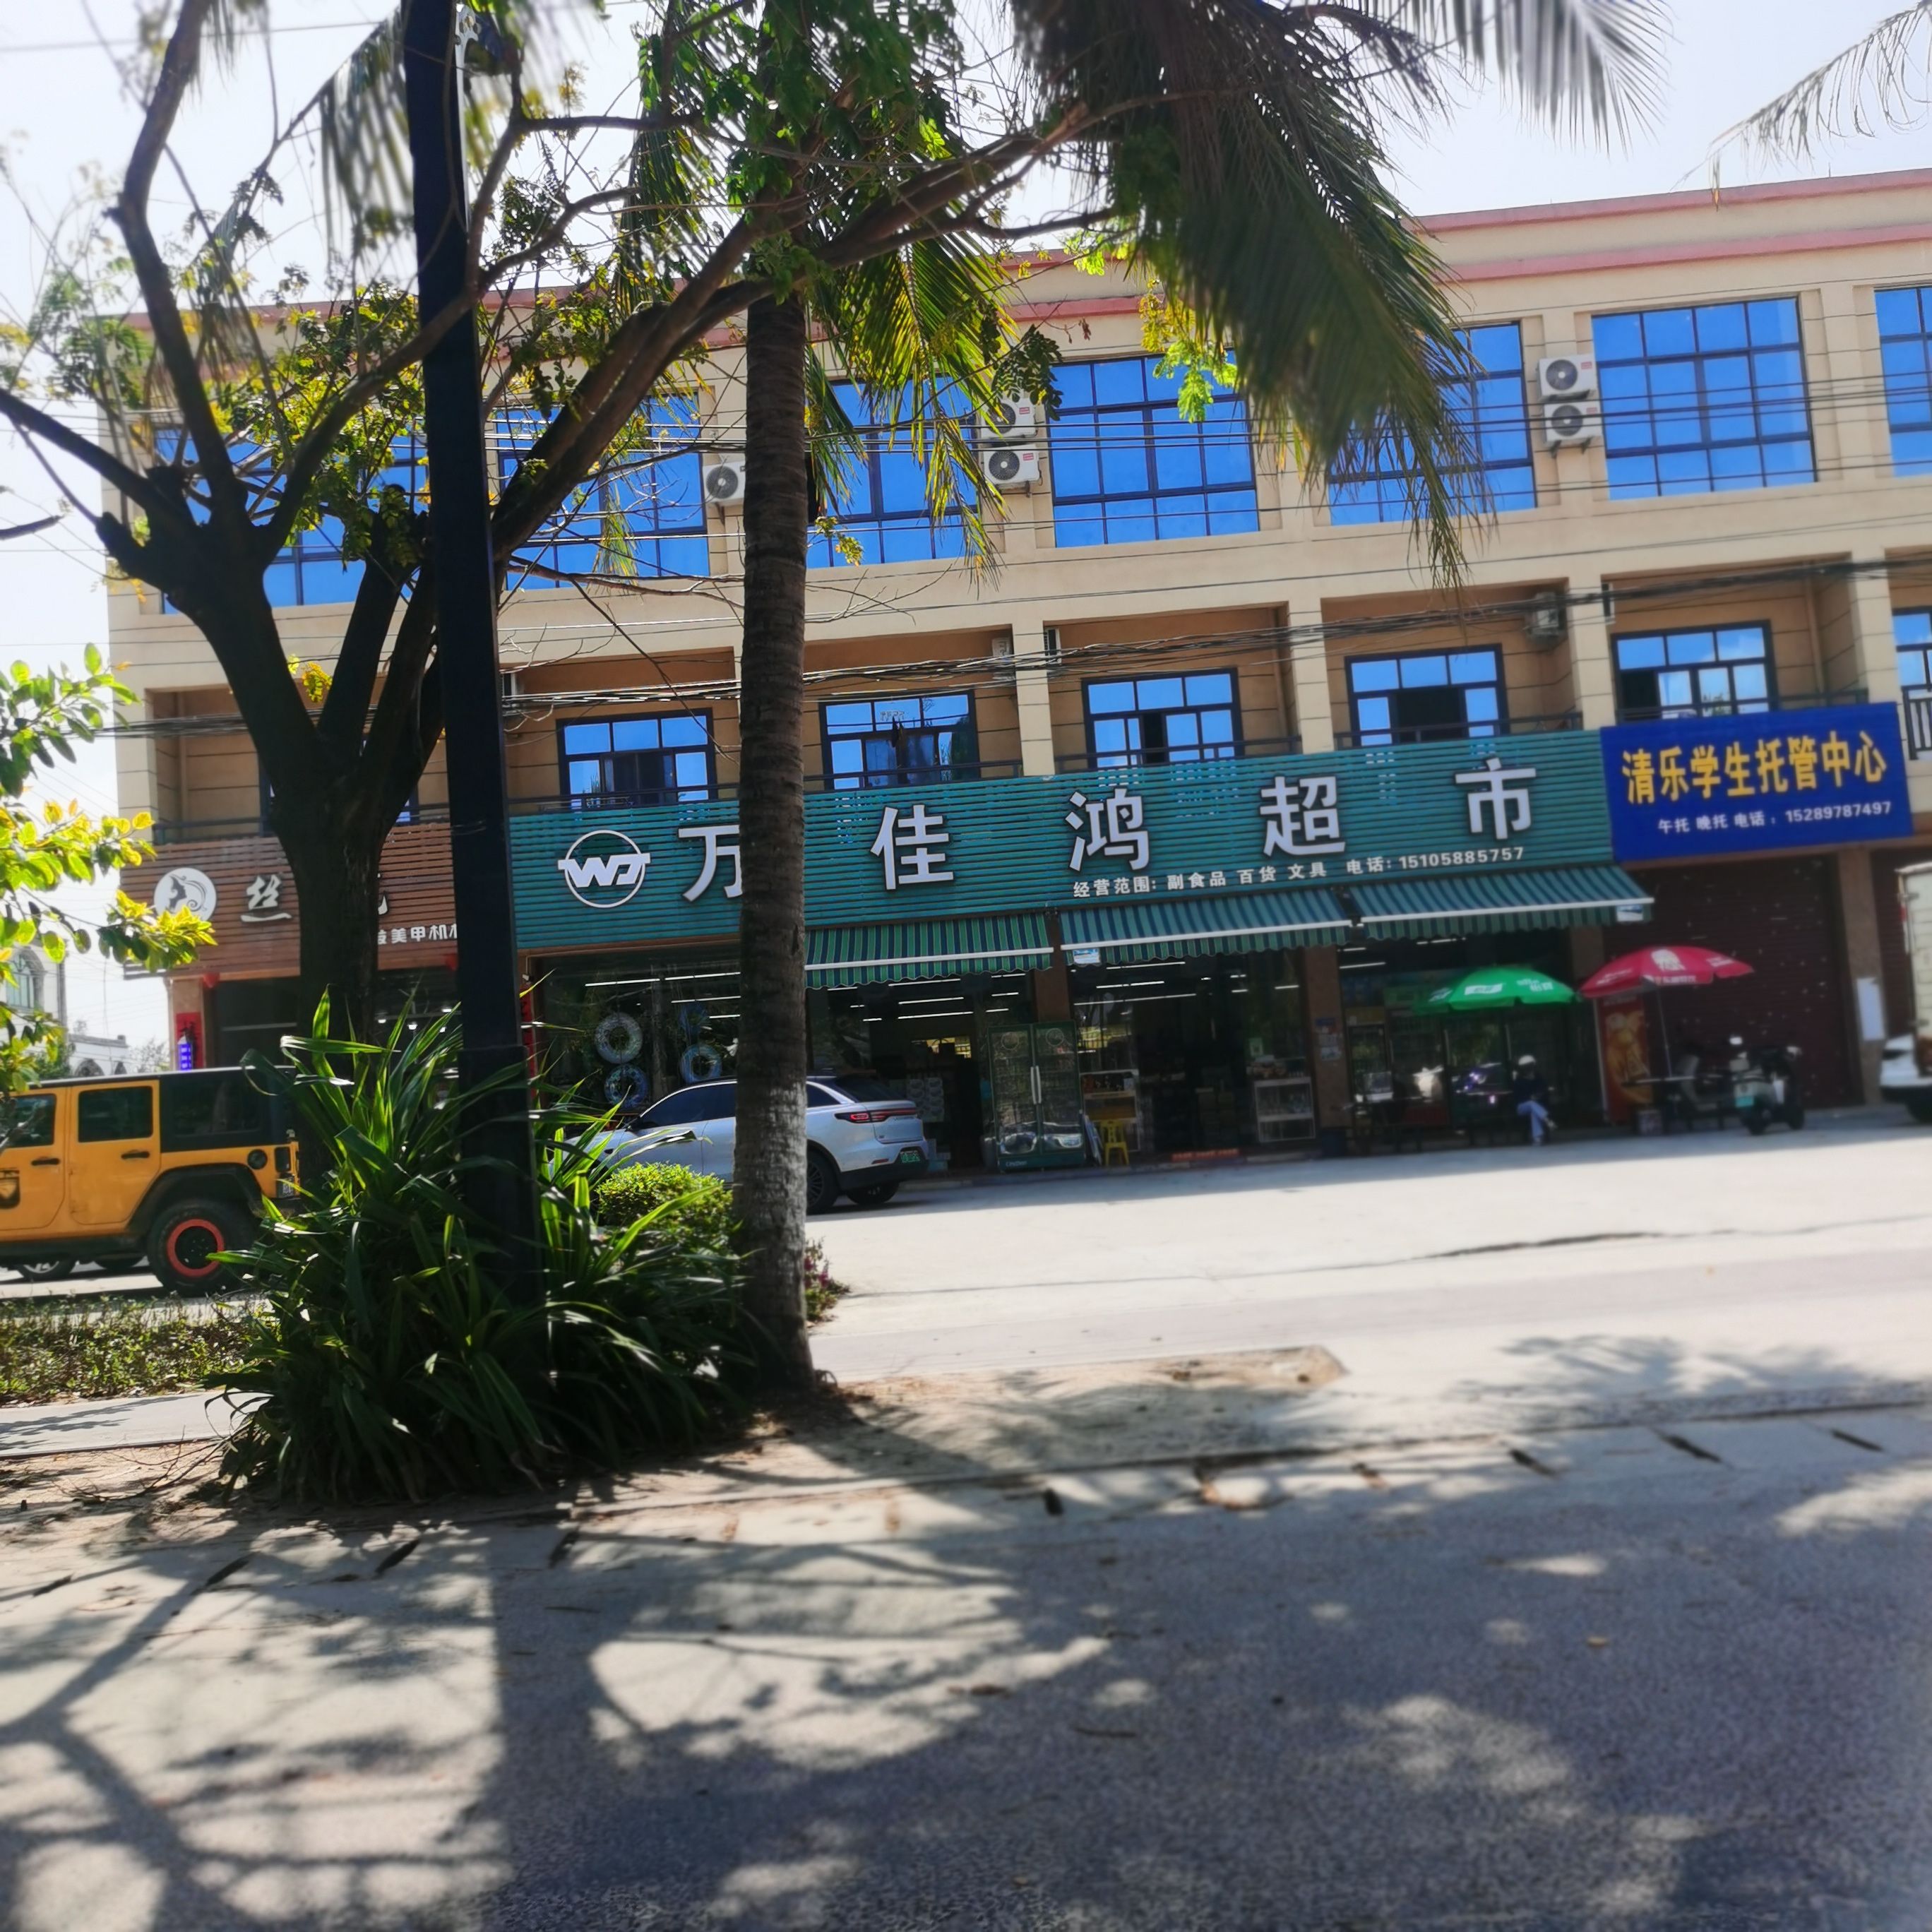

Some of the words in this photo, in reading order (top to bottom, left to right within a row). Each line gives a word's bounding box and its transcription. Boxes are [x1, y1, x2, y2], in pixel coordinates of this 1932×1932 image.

[1622, 730, 1888, 804] 清乐学生托管中心
[1658, 818, 1690, 835] 午托
[1398, 846, 1525, 869] 15105885757
